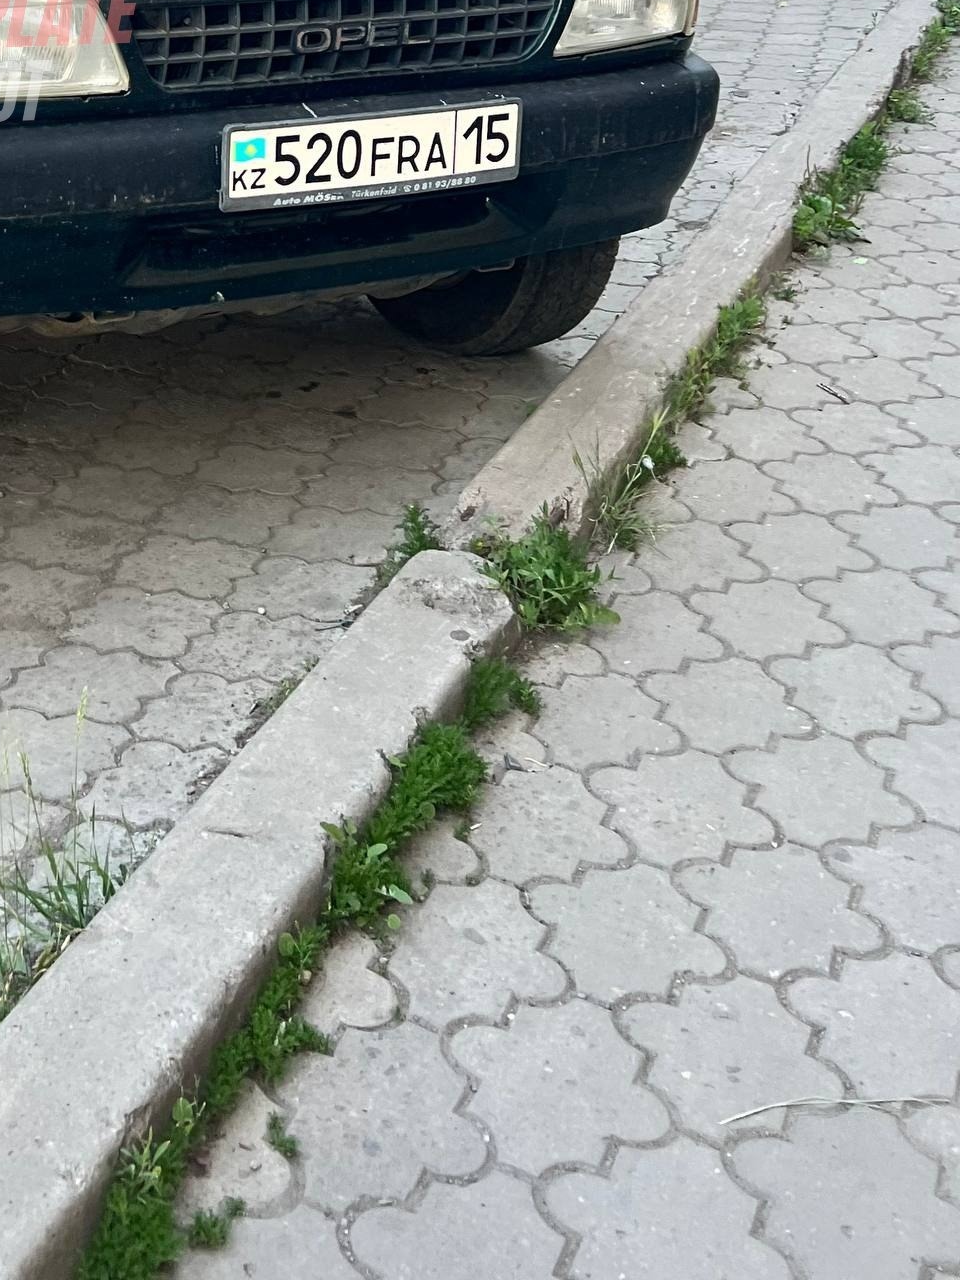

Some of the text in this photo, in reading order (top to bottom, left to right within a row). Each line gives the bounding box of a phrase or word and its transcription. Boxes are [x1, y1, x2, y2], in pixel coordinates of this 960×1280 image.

[296, 21, 431, 53] OPEL
[463, 113, 510, 165] 15
[232, 168, 267, 192] KZ
[273, 197, 301, 206] Auto
